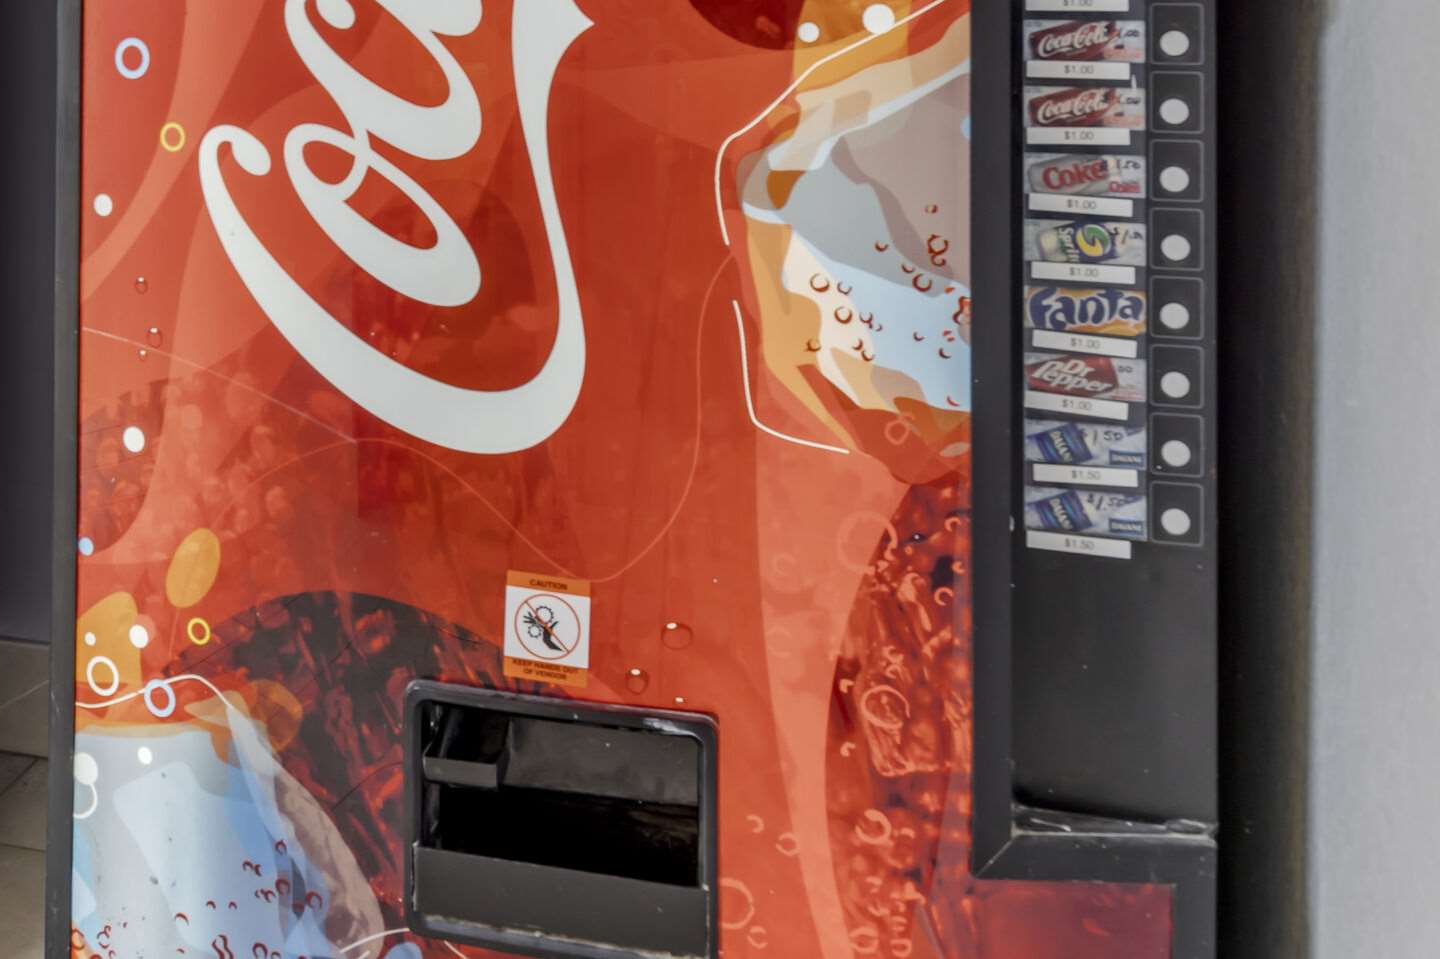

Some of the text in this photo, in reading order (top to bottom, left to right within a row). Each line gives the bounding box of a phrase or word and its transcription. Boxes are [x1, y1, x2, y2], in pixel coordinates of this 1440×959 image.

[1042, 159, 1109, 191] Coke
[1029, 287, 1144, 331] Fanta
[1032, 361, 1114, 392] Pepper
[1060, 358, 1097, 377] Dr
[529, 578, 569, 591] CAUTION
